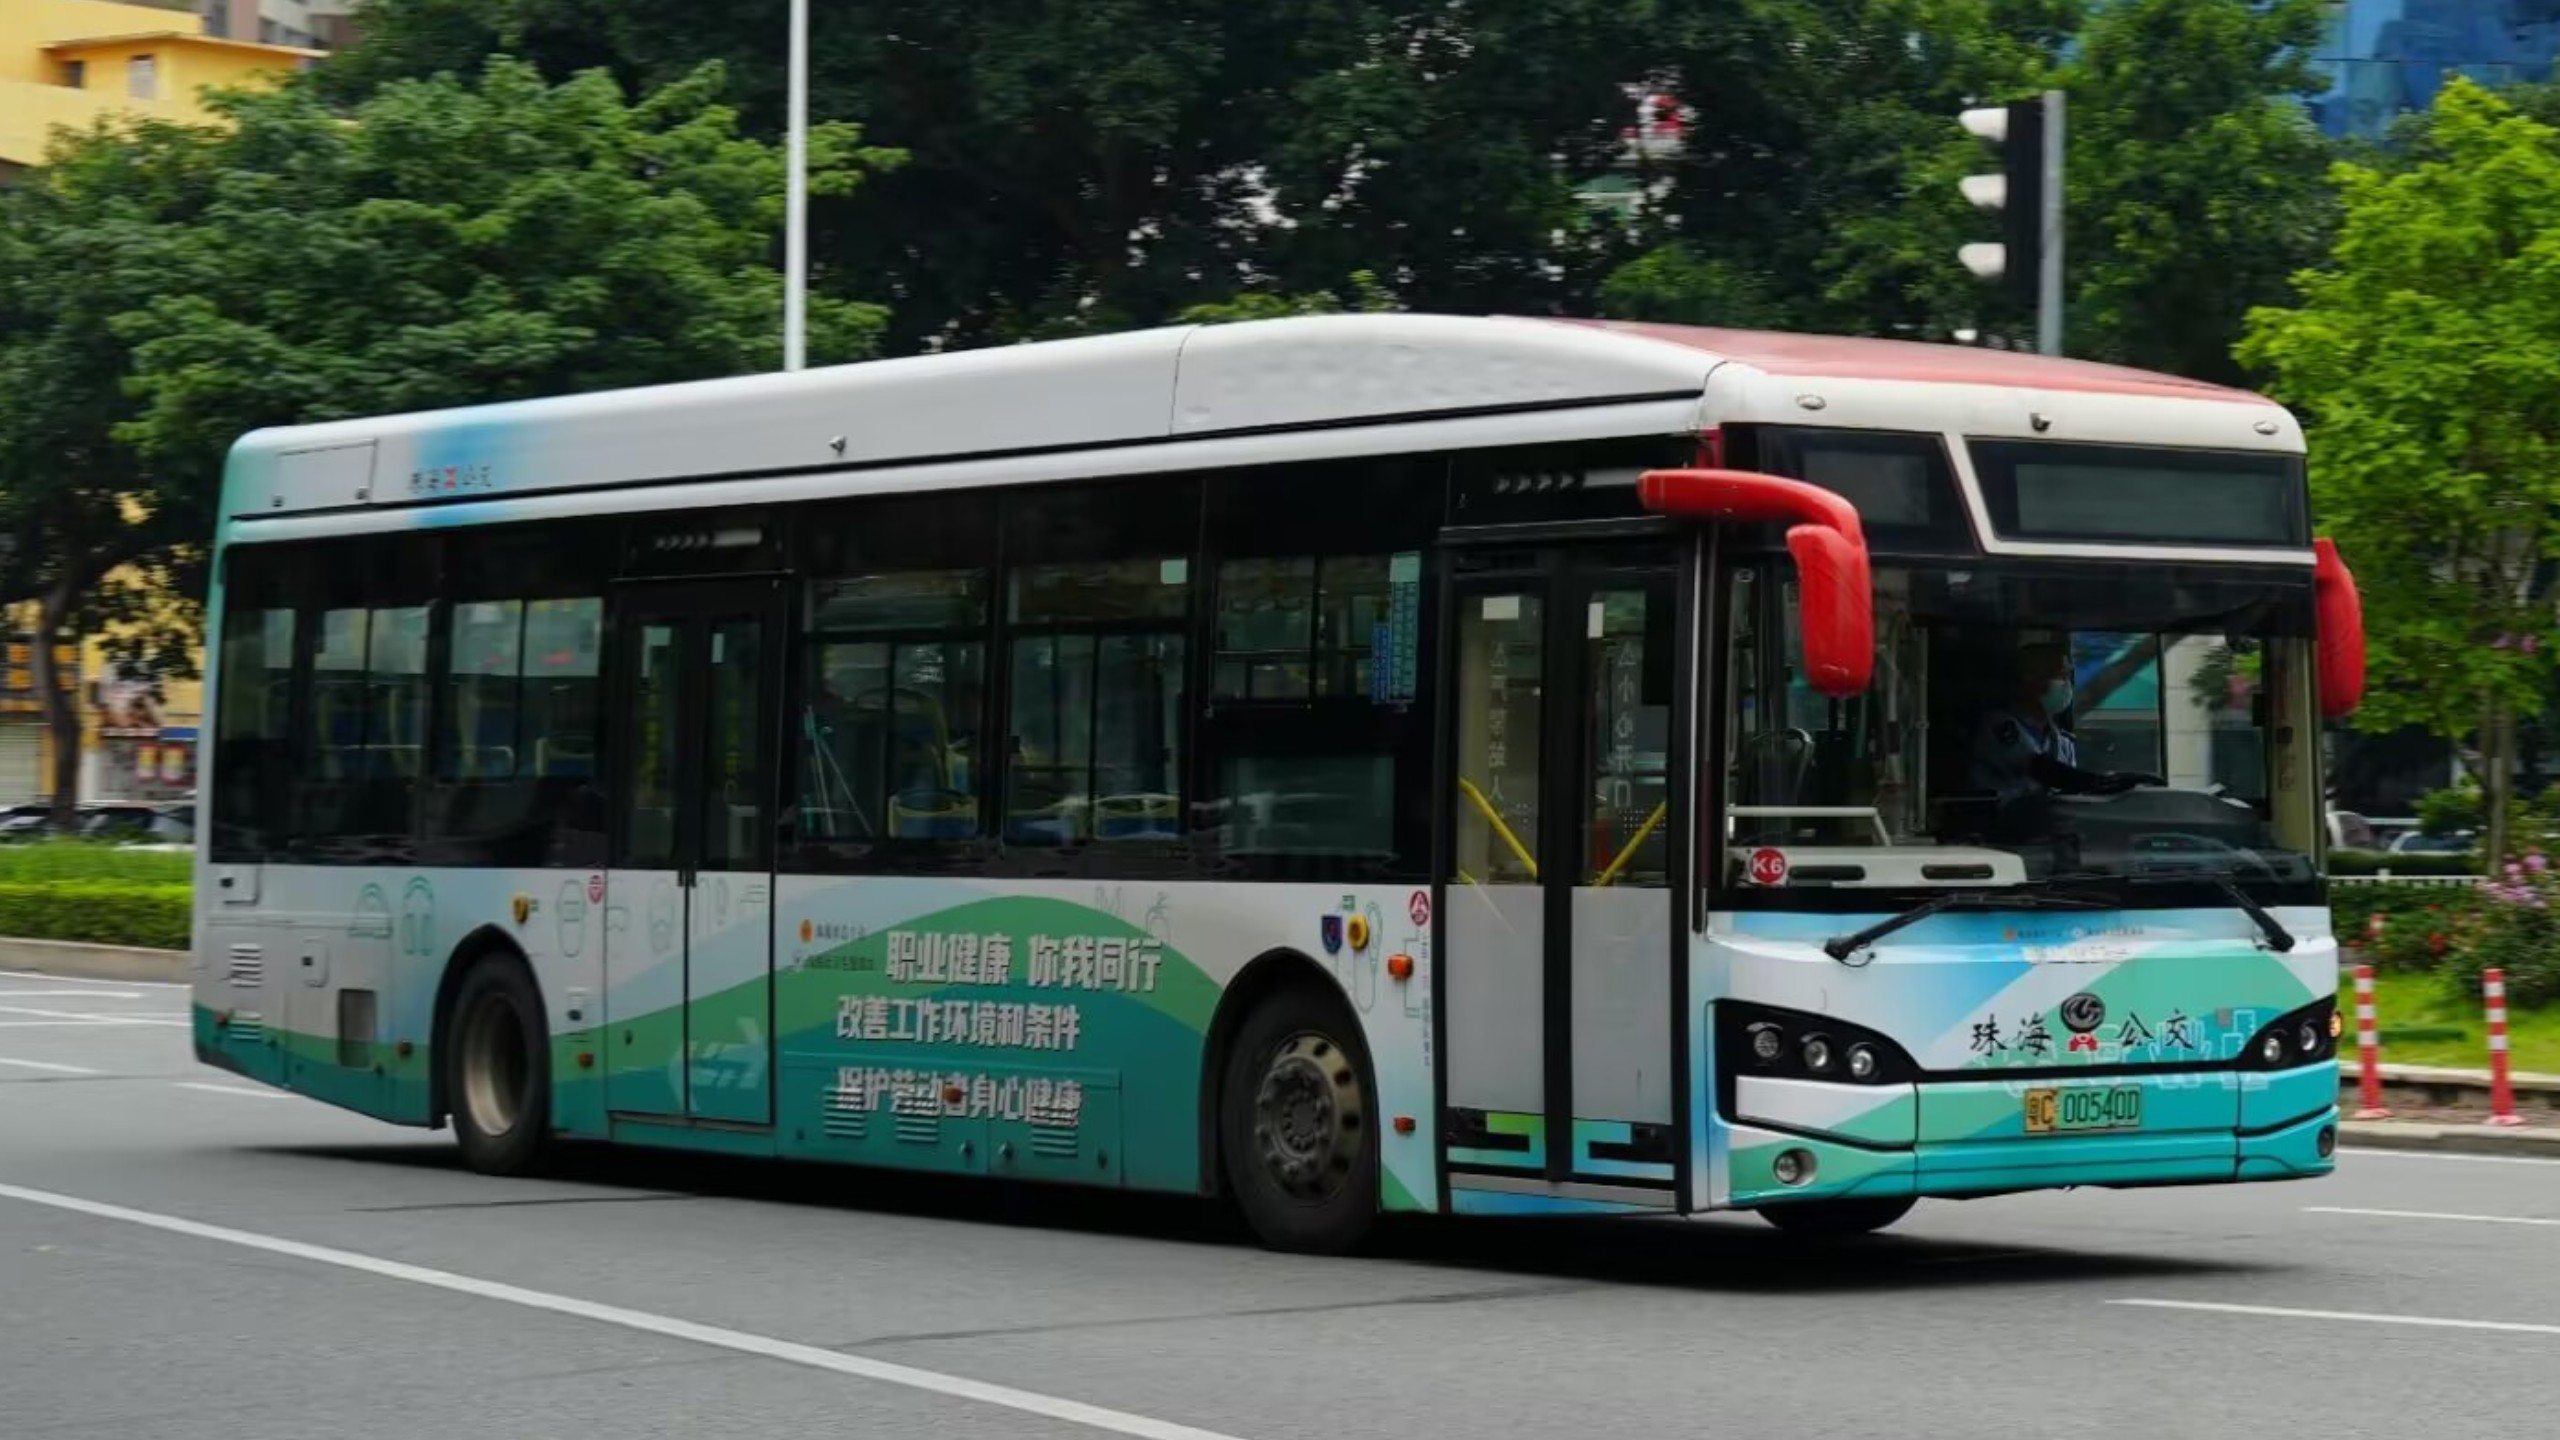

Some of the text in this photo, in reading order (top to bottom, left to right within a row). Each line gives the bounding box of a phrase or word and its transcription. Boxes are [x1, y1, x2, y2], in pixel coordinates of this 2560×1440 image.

[1752, 858, 1784, 875] K6
[886, 930, 1163, 992] 职业健康 你我同行
[837, 996, 1081, 1050] 改善工作环境和条件
[1969, 1008, 2196, 1058] 珠海 公交
[837, 1066, 1083, 1126] 保护劳动者身心健康
